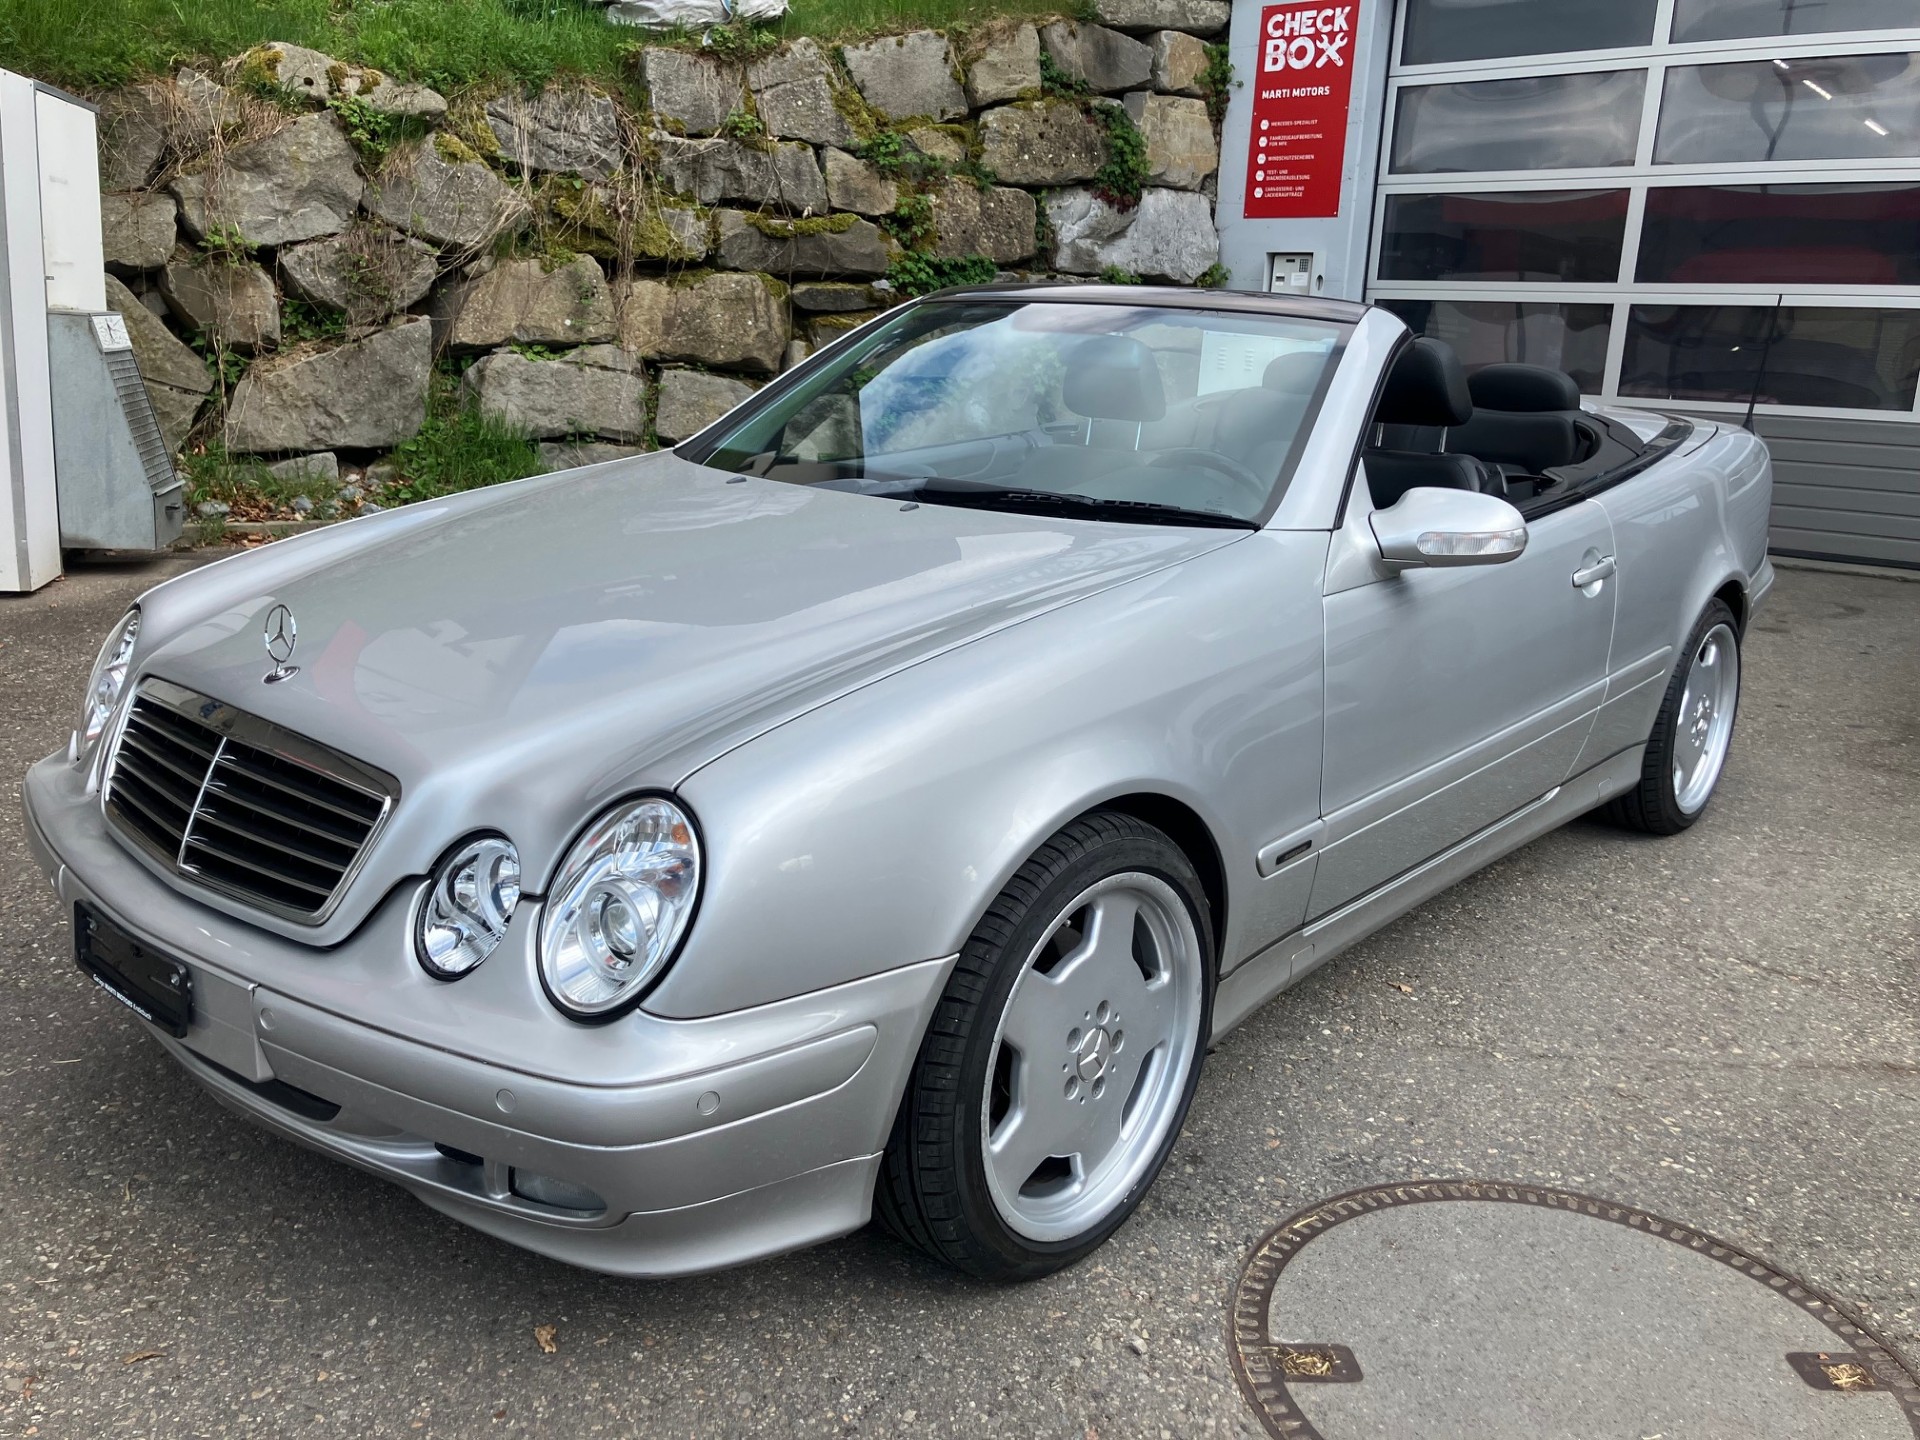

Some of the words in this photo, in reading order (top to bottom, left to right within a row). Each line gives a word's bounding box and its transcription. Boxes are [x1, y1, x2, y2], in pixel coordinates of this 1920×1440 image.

[1266, 6, 1352, 38] CHECK
[1263, 32, 1348, 73] BOX
[1261, 88, 1291, 100] MARTI
[1291, 85, 1331, 98] MOTORS
